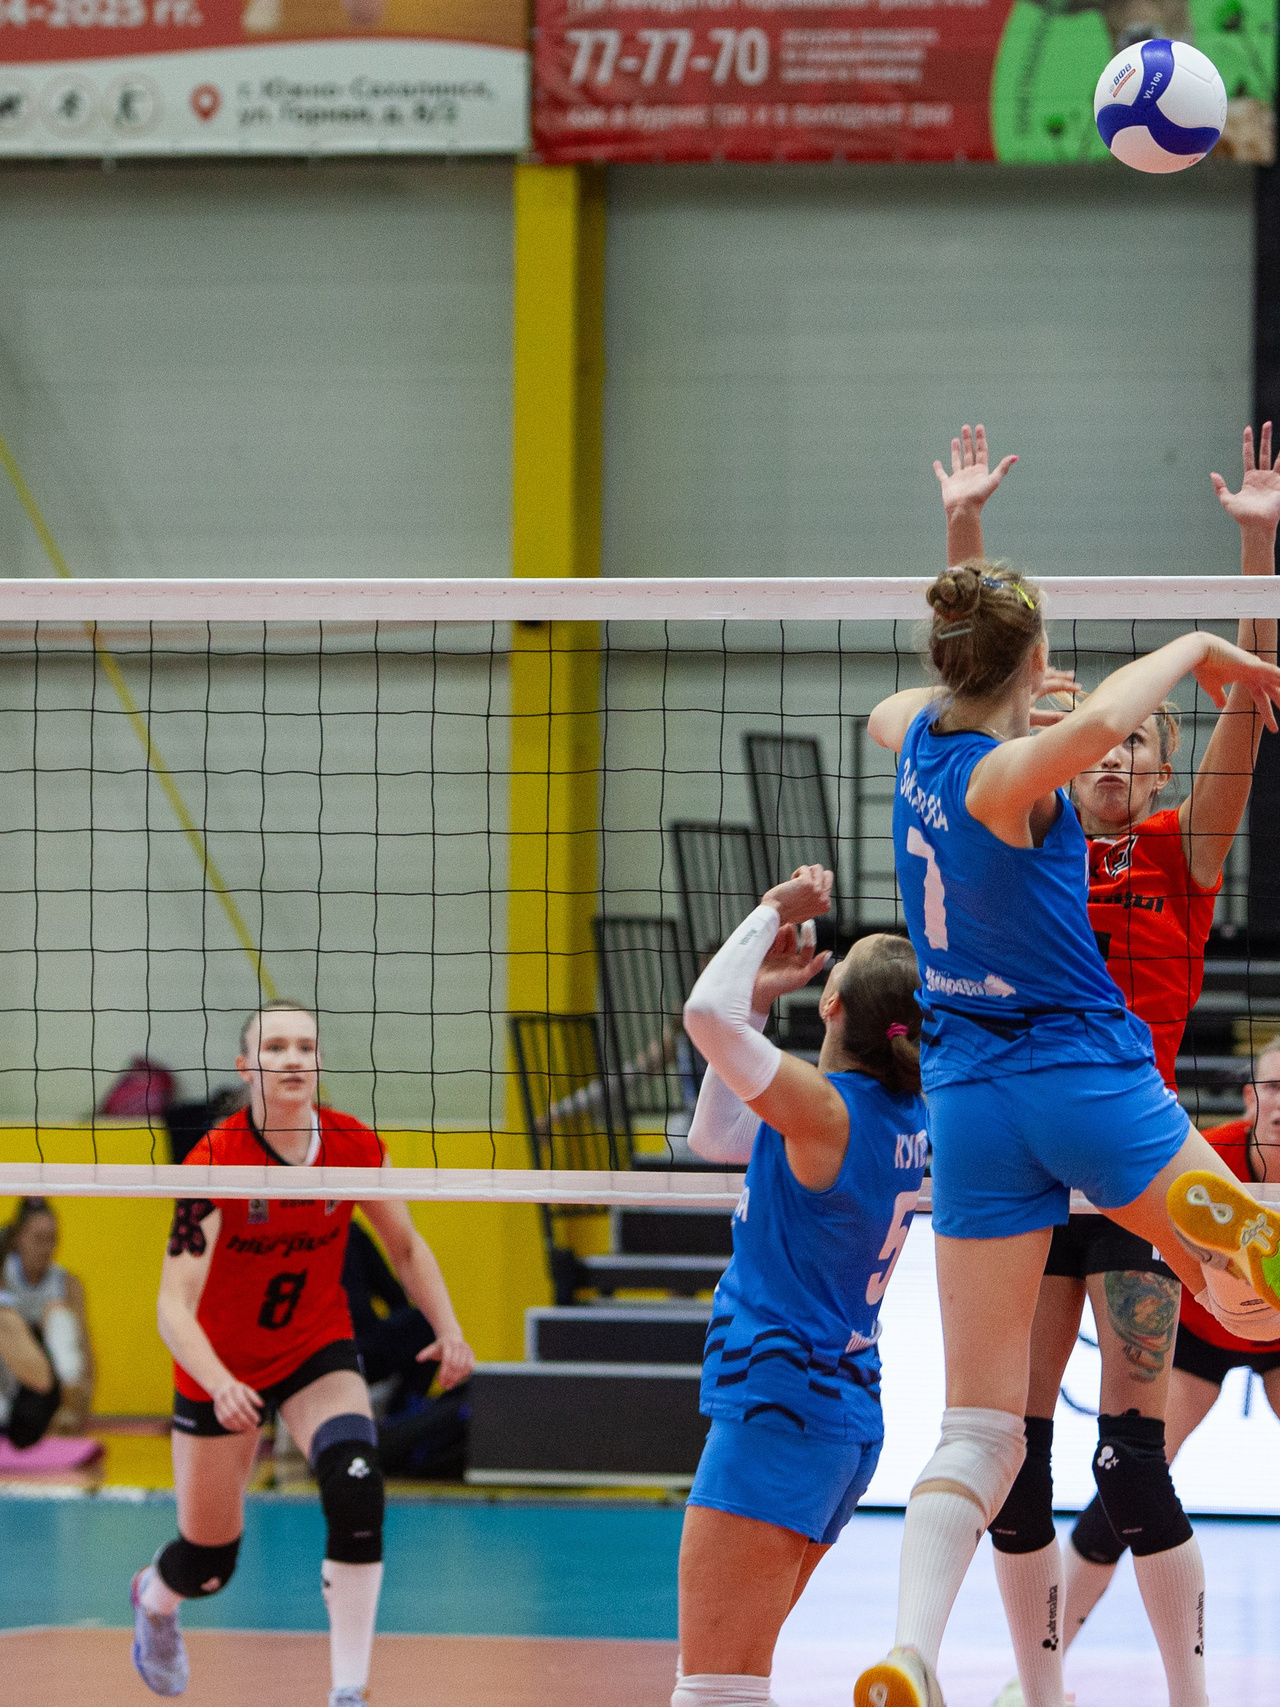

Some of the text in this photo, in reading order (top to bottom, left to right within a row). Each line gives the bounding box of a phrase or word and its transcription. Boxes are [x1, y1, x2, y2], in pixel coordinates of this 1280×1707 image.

[565, 27, 771, 86] 77-77-70
[1143, 71, 1164, 99] VL-100
[865, 1190, 920, 1306] 5
[257, 1268, 308, 1331] 8
